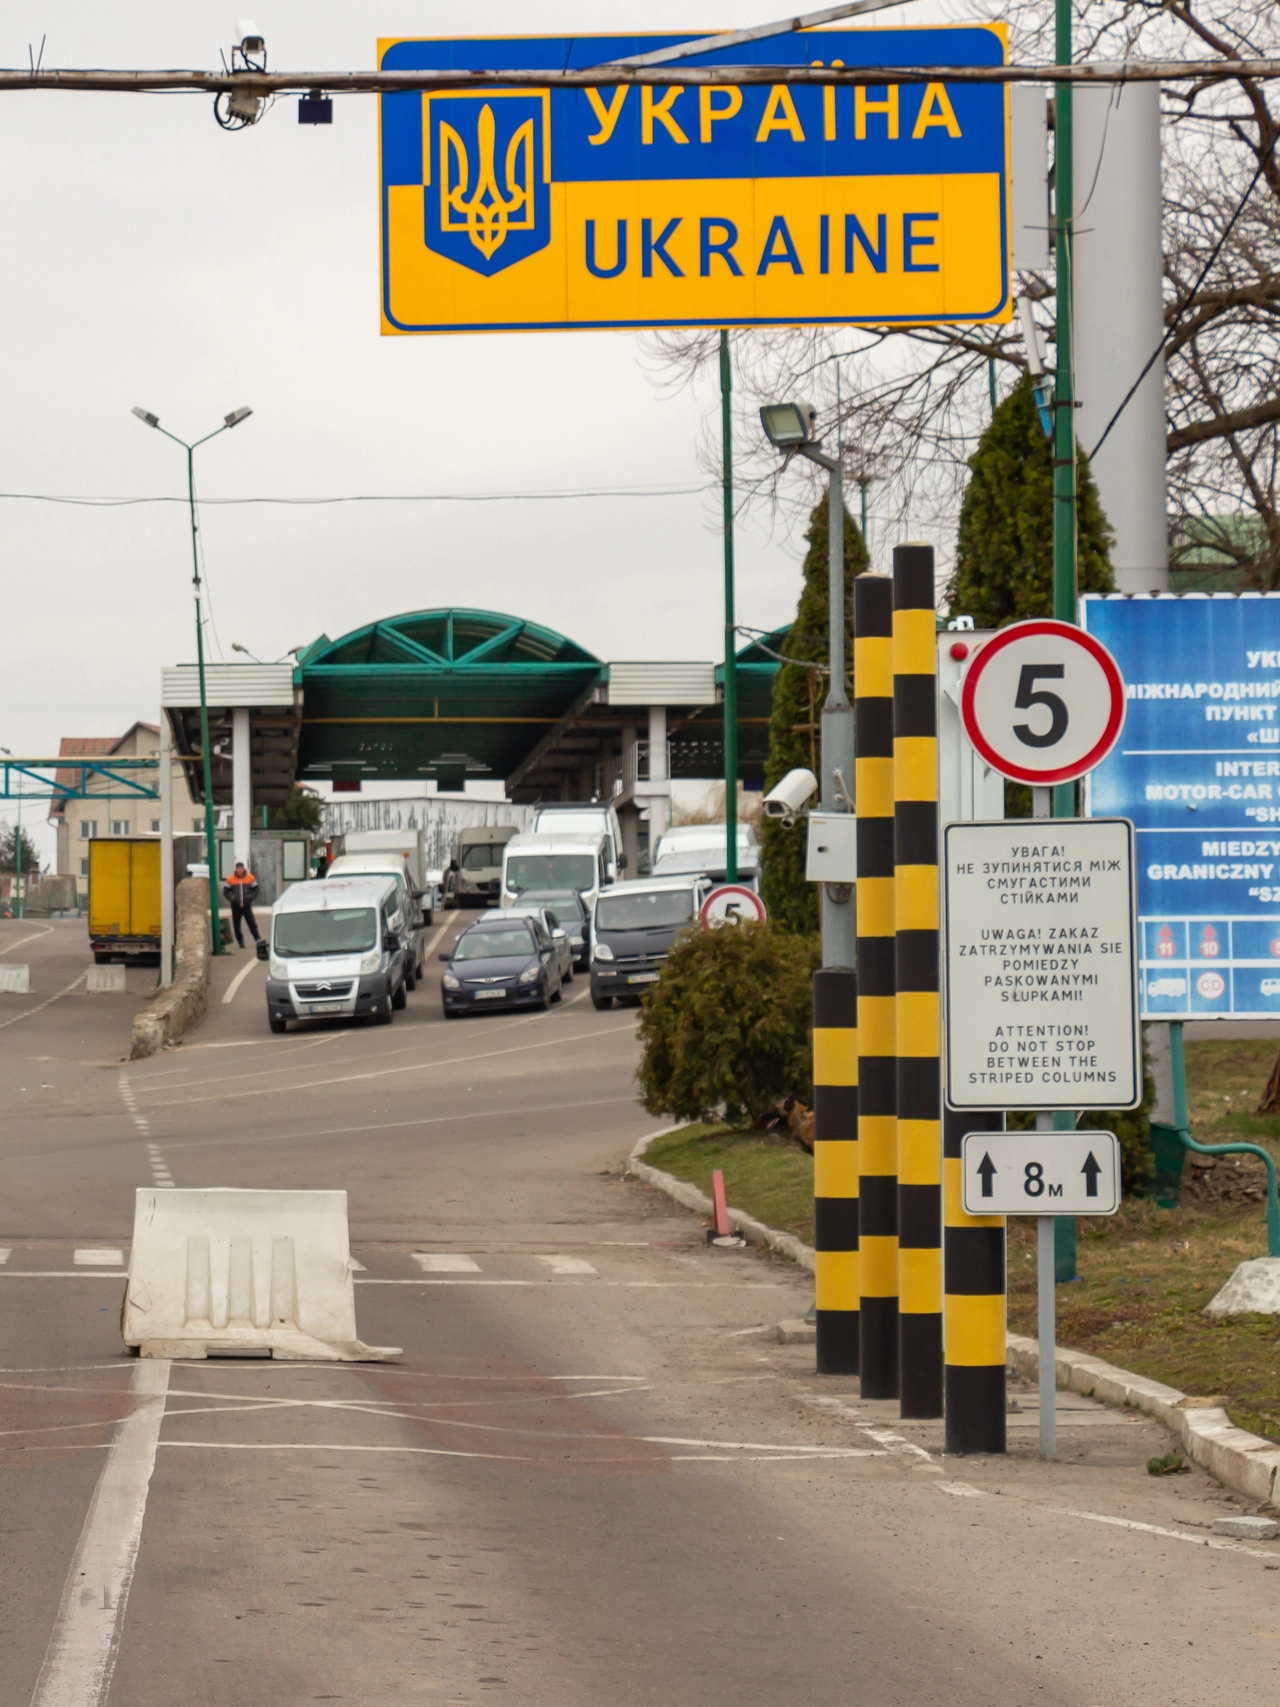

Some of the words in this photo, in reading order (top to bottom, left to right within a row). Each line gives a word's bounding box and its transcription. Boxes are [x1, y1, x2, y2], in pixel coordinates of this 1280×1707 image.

[586, 212, 939, 278] UKRAINE
[1246, 650, 1280, 669] УК
[1012, 663, 1069, 748] 5
[1205, 704, 1278, 721] ПУНКТ
[1145, 783, 1273, 800] MOTOR-CAR
[1011, 846, 1065, 858] УВАГА!
[957, 863, 974, 874] НЕ
[983, 860, 1082, 874] ЗУПИНЯТИСЯ
[1090, 860, 1121, 871] МІЖ
[1147, 863, 1275, 880] GRANICZNY
[987, 876, 1091, 889] СМУГАСТИМИ
[1000, 890, 1078, 905] СТІЙКАМИ
[981, 928, 1041, 940] UWAGA!
[1049, 927, 1098, 939] ZAKAZ
[959, 943, 1092, 956] ZATRZYMYWANIA
[1100, 942, 1122, 954] SIE
[1159, 942, 1173, 956] 11
[1202, 942, 1219, 956] 10
[984, 974, 1098, 987] PASKOWANYMI
[1201, 980, 1221, 991] CD
[995, 1025, 1089, 1037] ATTENTION!
[989, 1041, 1009, 1053] DO
[1017, 1041, 1047, 1052] NOT
[1056, 1040, 1095, 1052] STOP
[987, 1056, 1061, 1068] BETWEEN
[1069, 1055, 1098, 1067] THE
[969, 1072, 1034, 1084] STRIPED
[1042, 1071, 1117, 1083] COLUMNS
